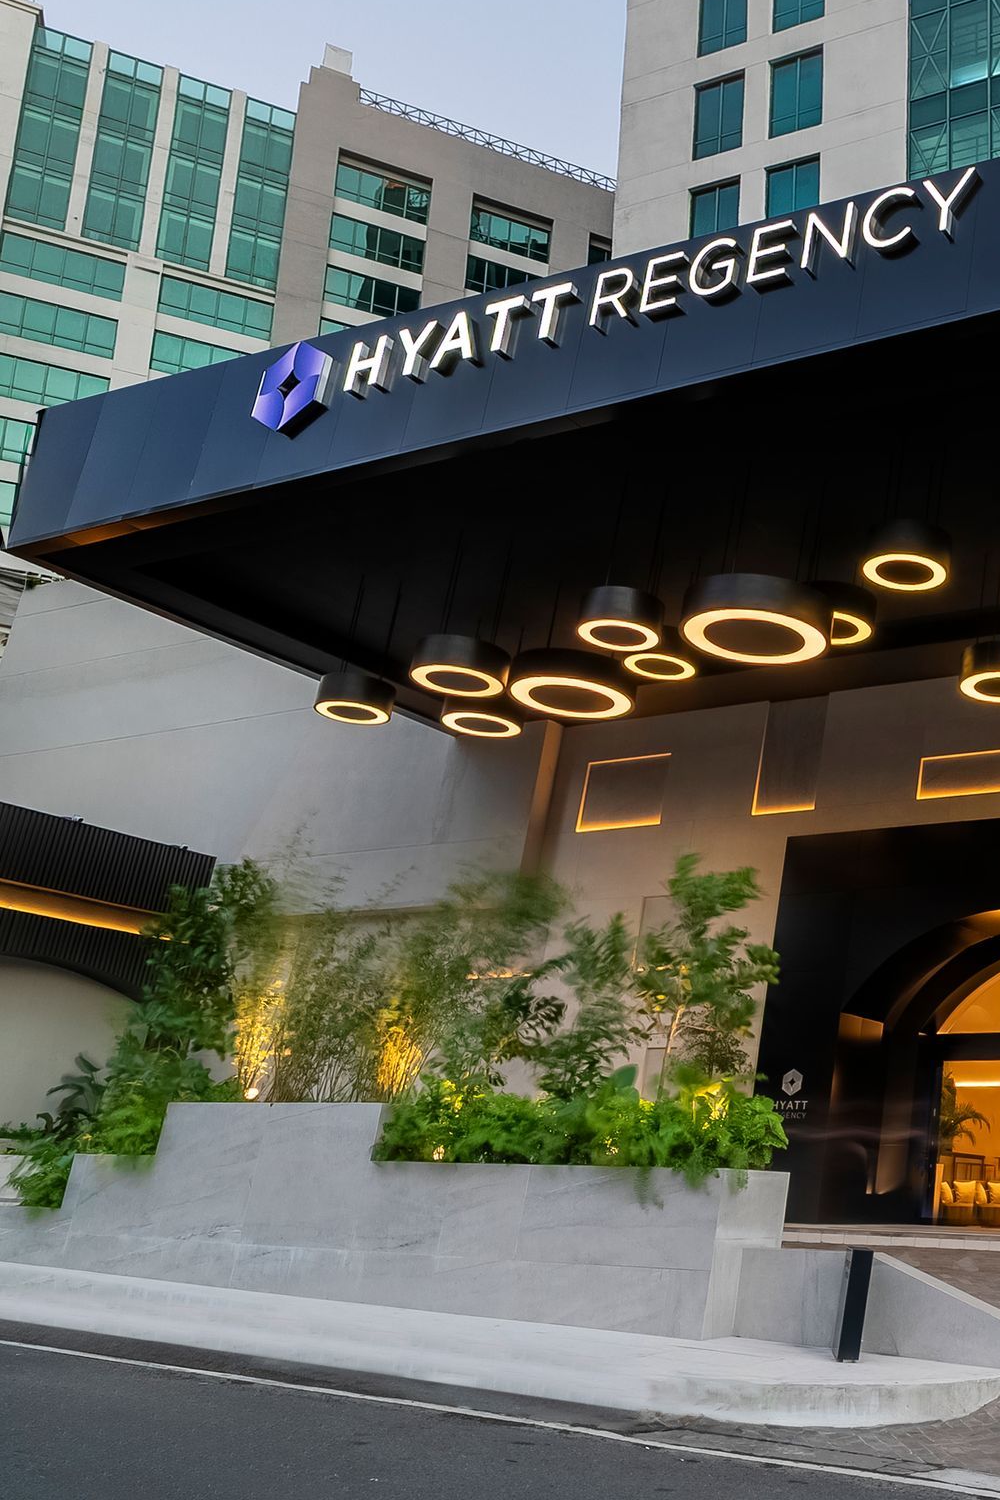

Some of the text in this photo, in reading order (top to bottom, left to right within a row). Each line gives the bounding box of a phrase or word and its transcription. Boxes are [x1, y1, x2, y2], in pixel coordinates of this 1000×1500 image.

[342, 166, 979, 396] HYATT REGENCY
[773, 1100, 808, 1110] HYATT
